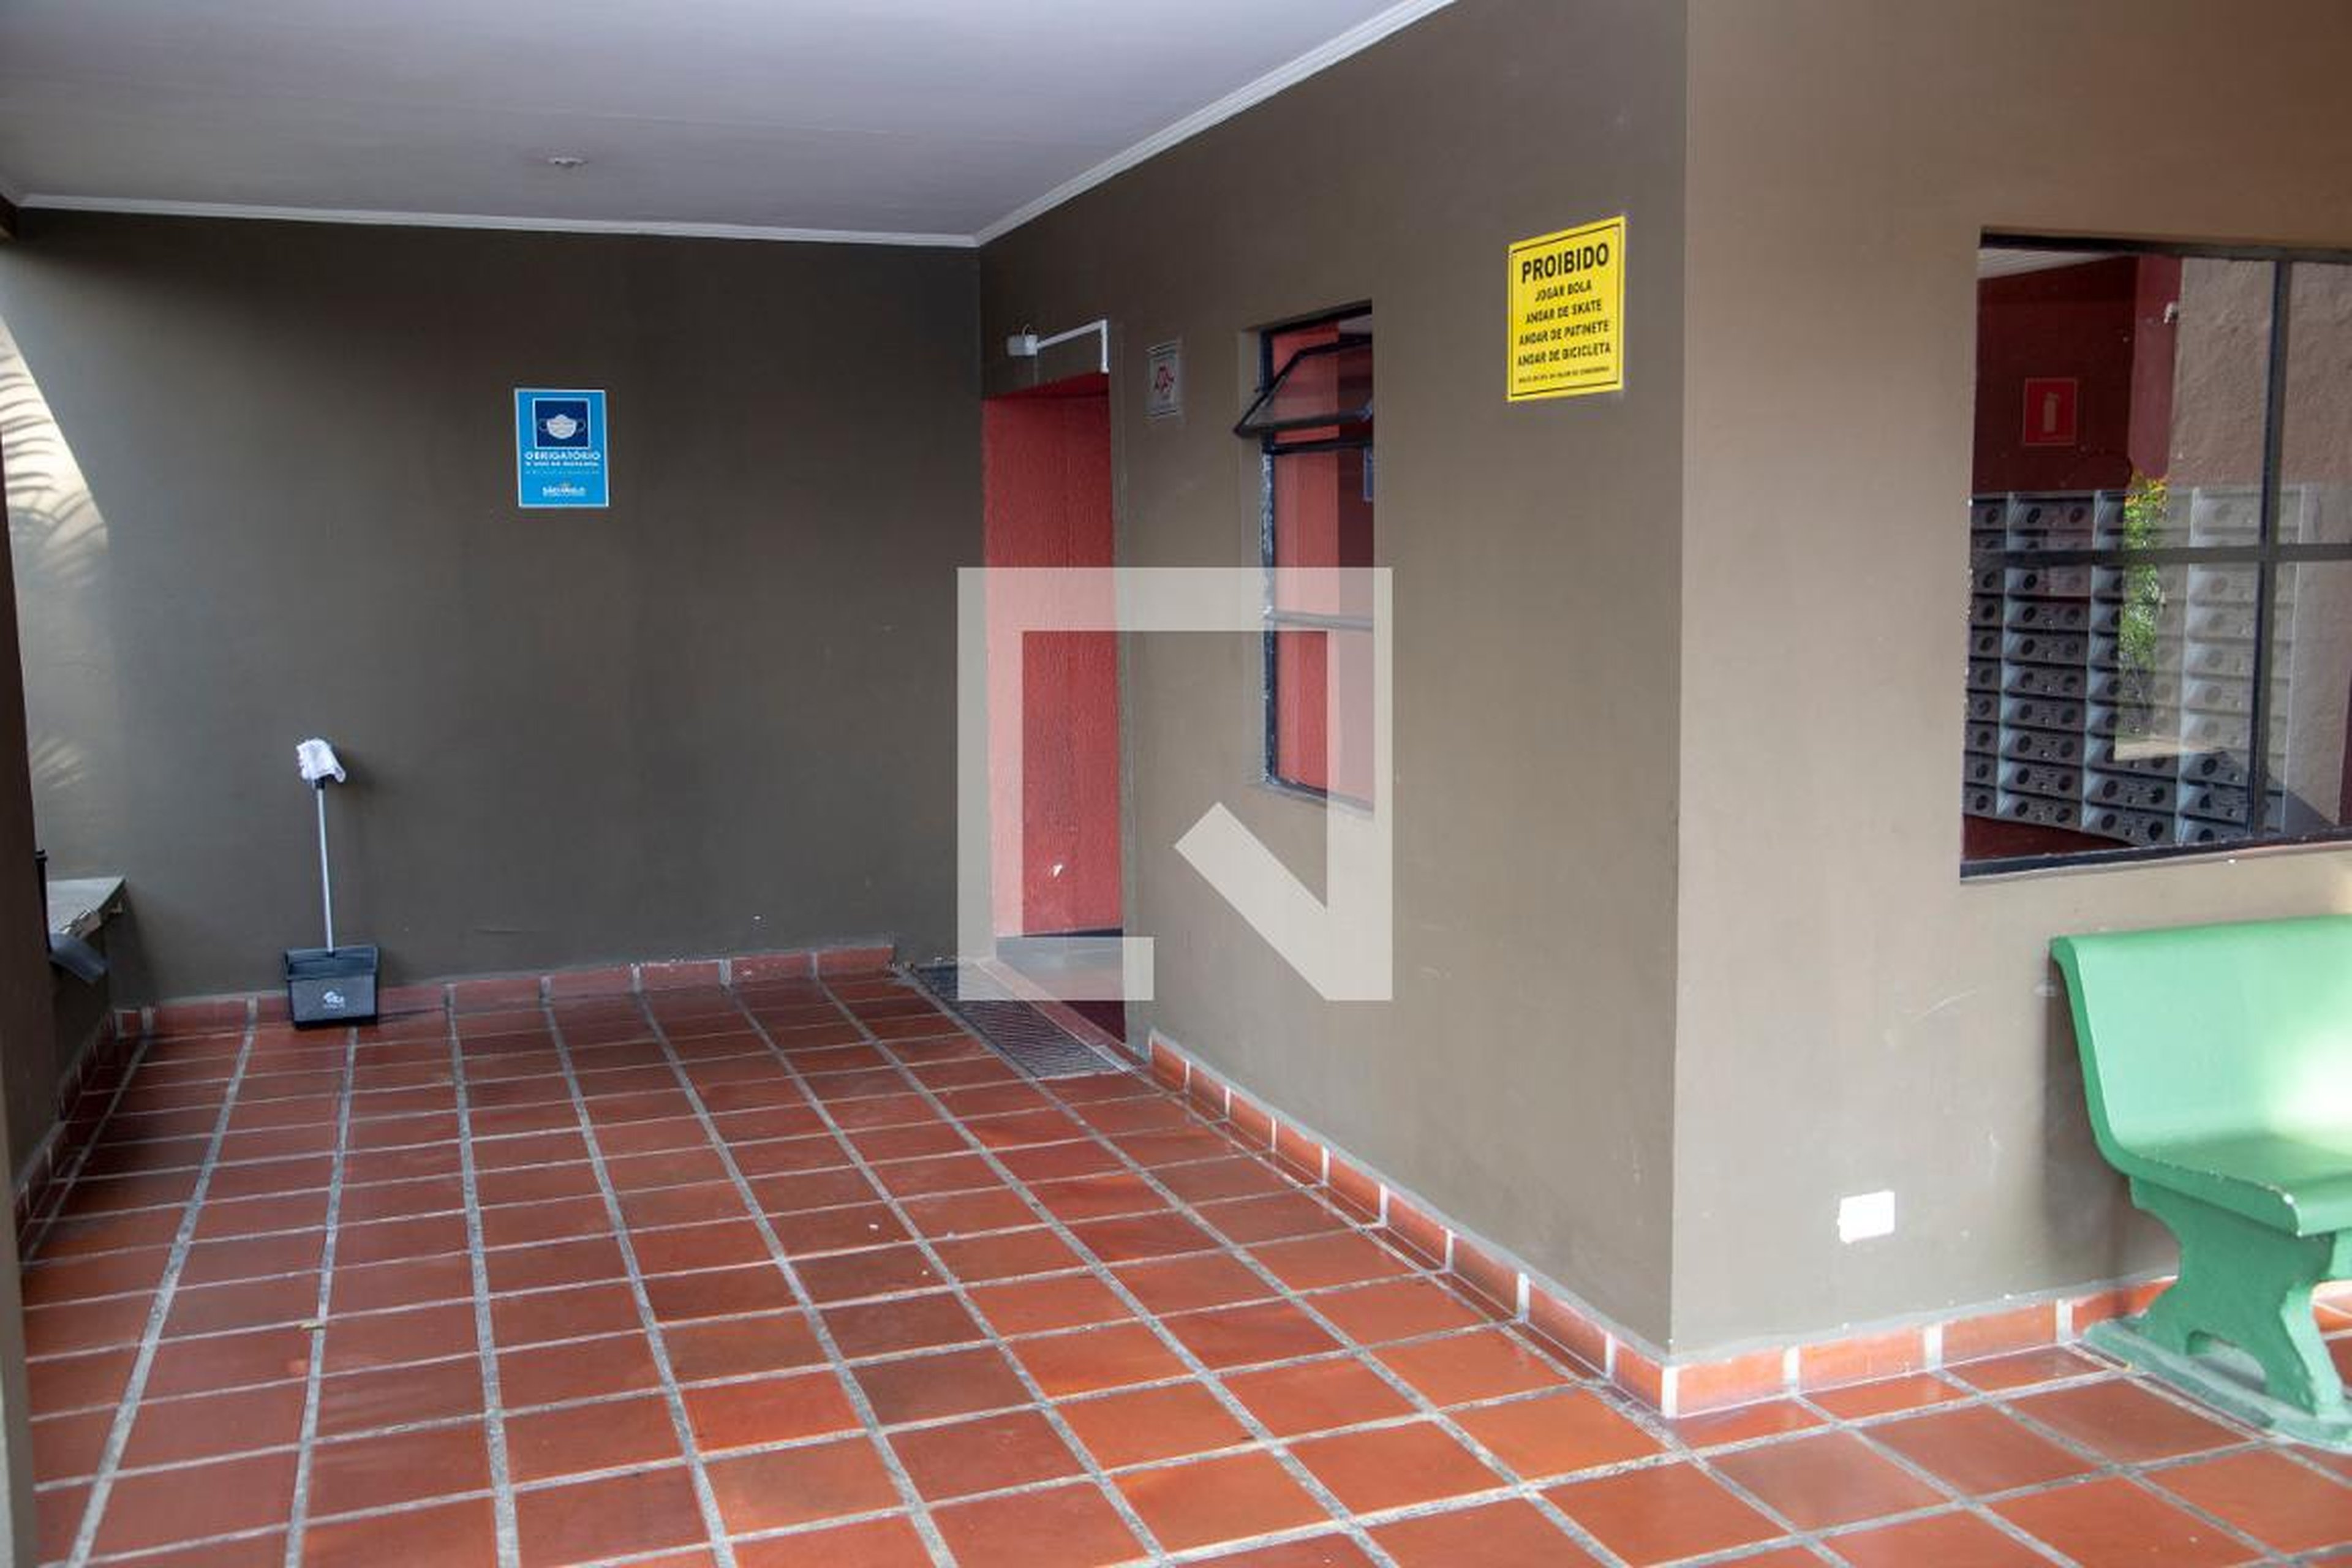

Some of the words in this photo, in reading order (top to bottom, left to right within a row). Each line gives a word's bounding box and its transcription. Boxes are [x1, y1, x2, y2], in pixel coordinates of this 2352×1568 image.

[1521, 243, 1609, 284] PROIBIDO
[1535, 285, 1564, 301] JOGAR
[1567, 279, 1591, 295] BOLA
[1526, 308, 1555, 324] ANDAR
[1558, 306, 1569, 318] DE
[1572, 298, 1602, 315] SKATE
[1519, 330, 1548, 345] ANDAR
[1550, 328, 1562, 340] DE
[1564, 319, 1609, 338] PATINETE
[1518, 351, 1547, 366] ANDAR
[1549, 349, 1560, 362] DE
[1562, 342, 1611, 360] BICICLETA
